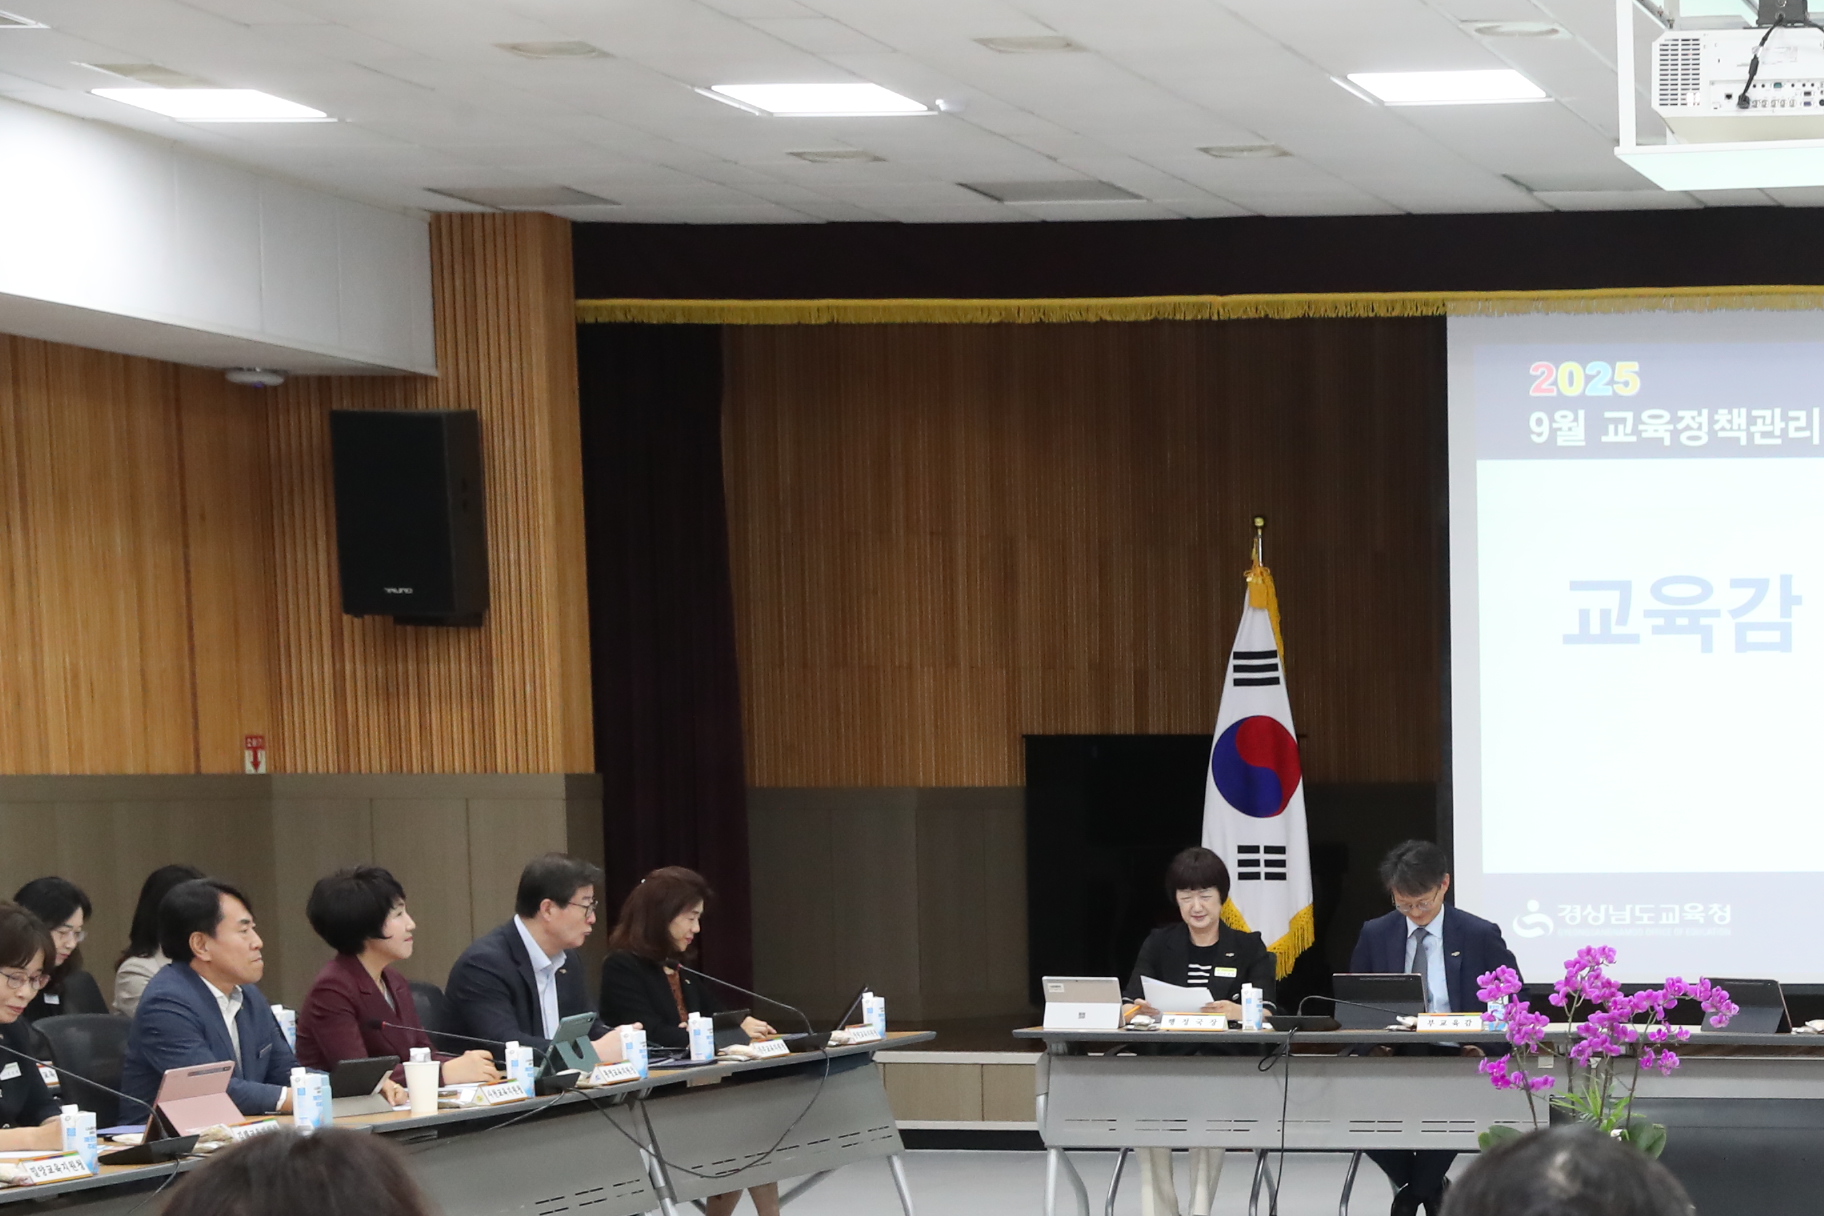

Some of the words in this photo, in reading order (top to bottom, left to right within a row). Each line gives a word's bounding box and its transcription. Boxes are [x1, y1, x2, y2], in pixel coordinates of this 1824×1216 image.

[1529, 361, 1640, 396] 2025
[1529, 408, 1586, 446] 9월
[1562, 573, 1803, 654] 교육감
[1557, 902, 1732, 926] 경상남도교육청
